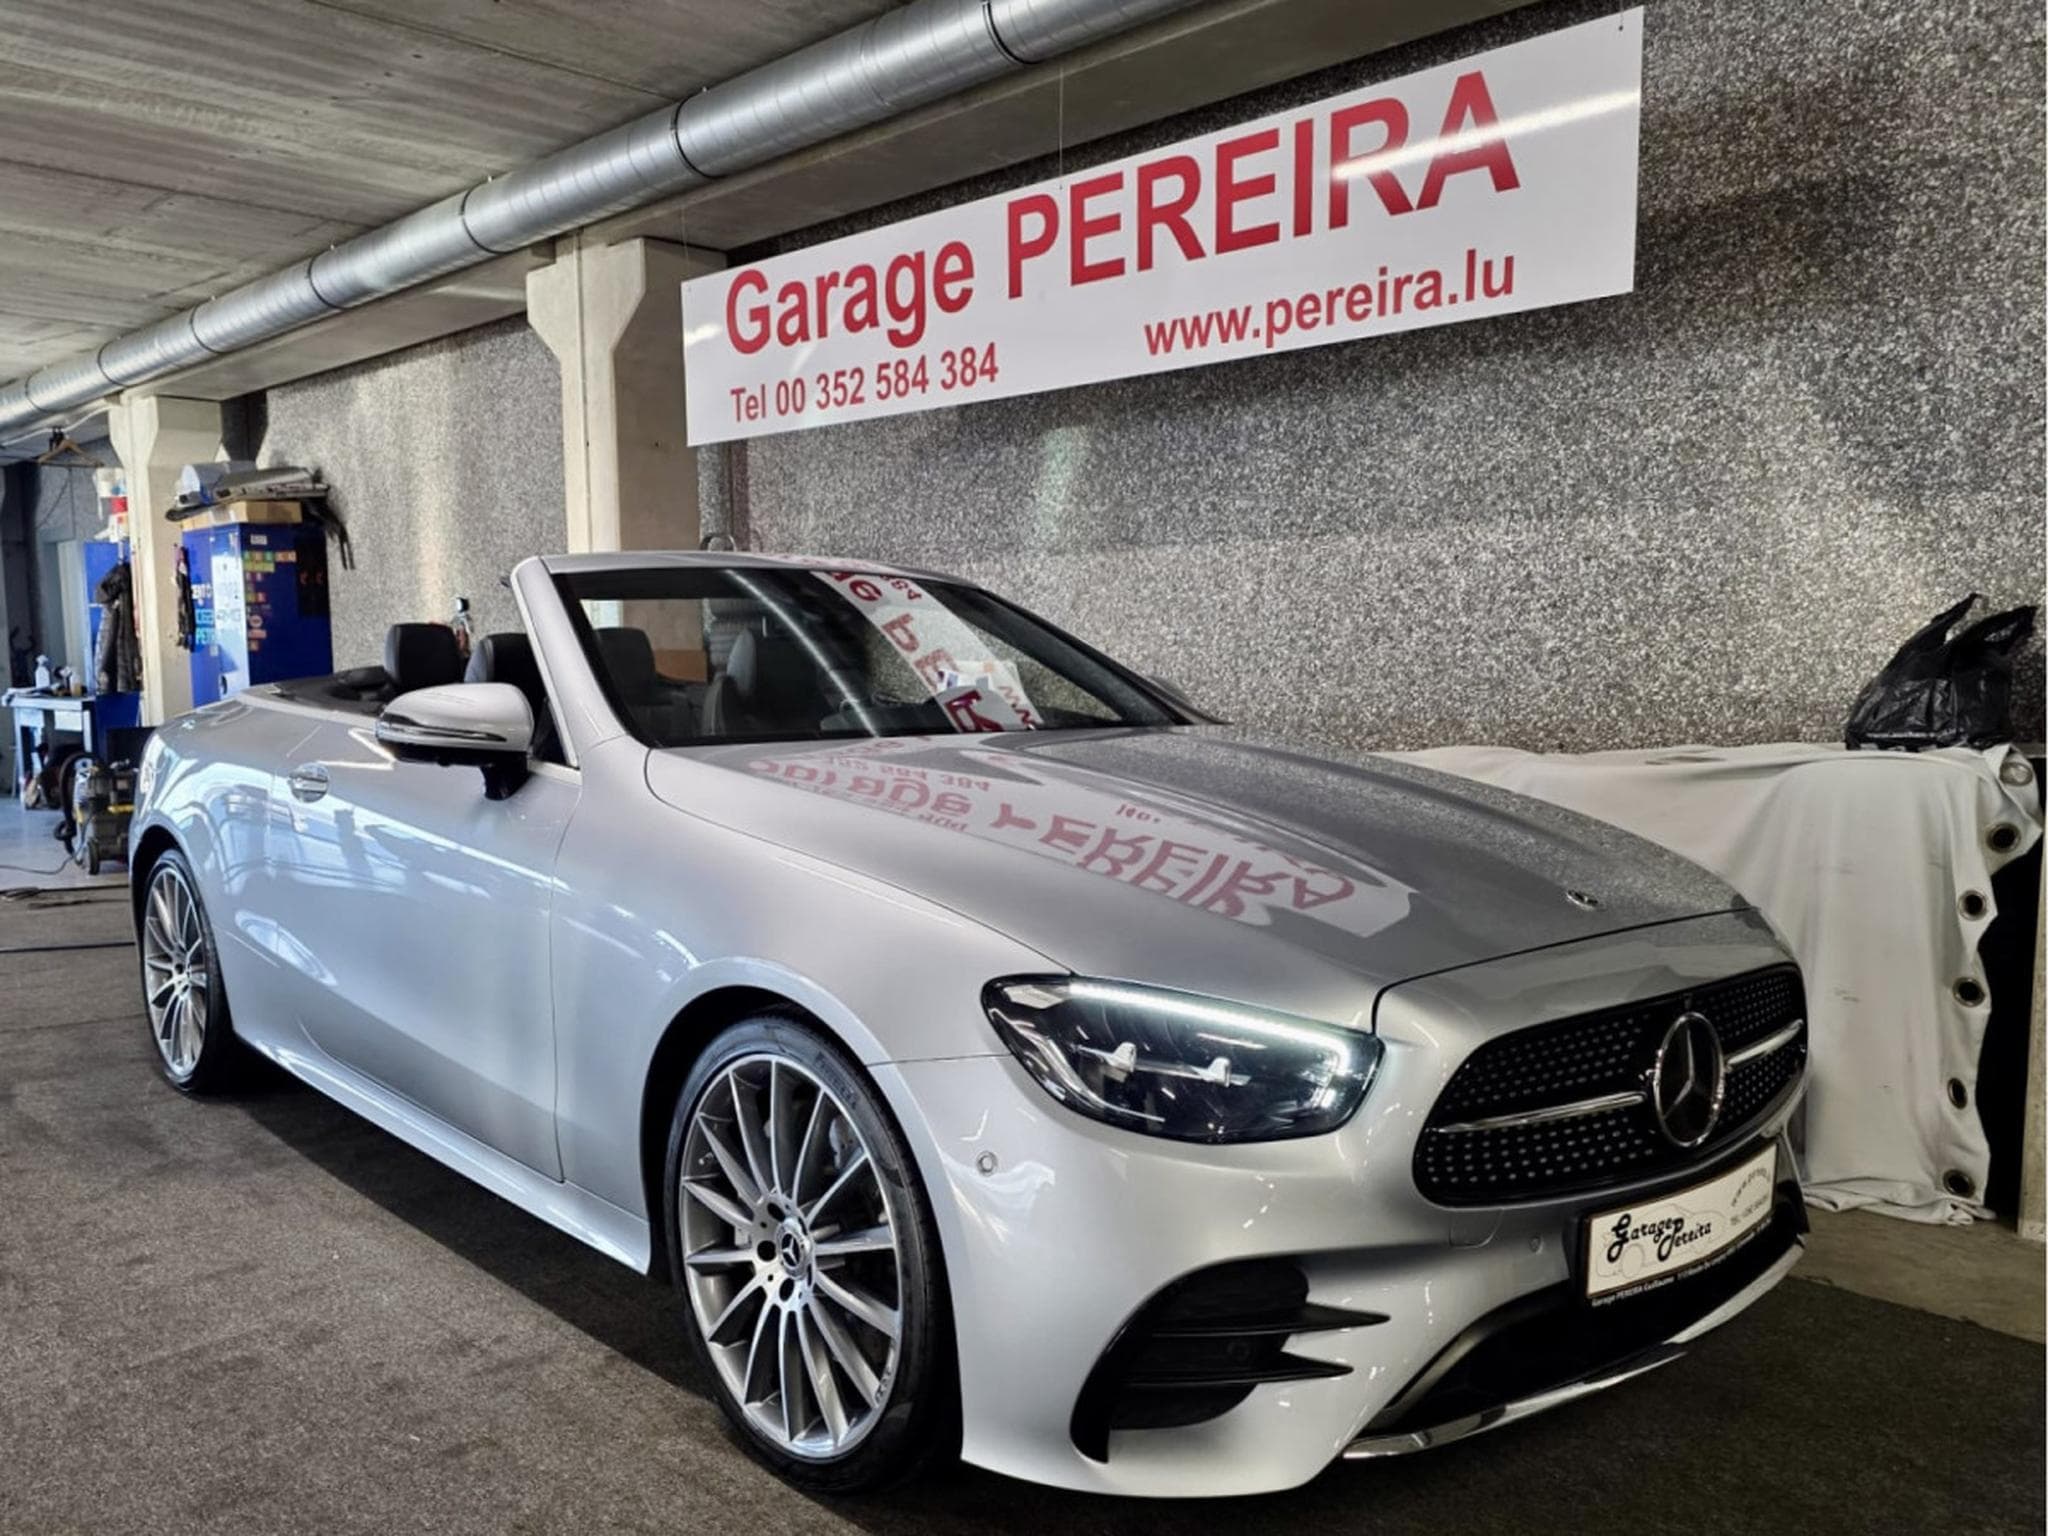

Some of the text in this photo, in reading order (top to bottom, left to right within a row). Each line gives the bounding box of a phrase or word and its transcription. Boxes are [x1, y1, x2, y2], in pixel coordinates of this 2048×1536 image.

[725, 70, 1521, 356] Garage PEREIRA
[1143, 248, 1515, 357] www.pereira.lu
[730, 342, 1000, 422] Tel 00 352 584 384
[1606, 1213, 1674, 1263] Garage
[1656, 1216, 1712, 1262] Pereira
